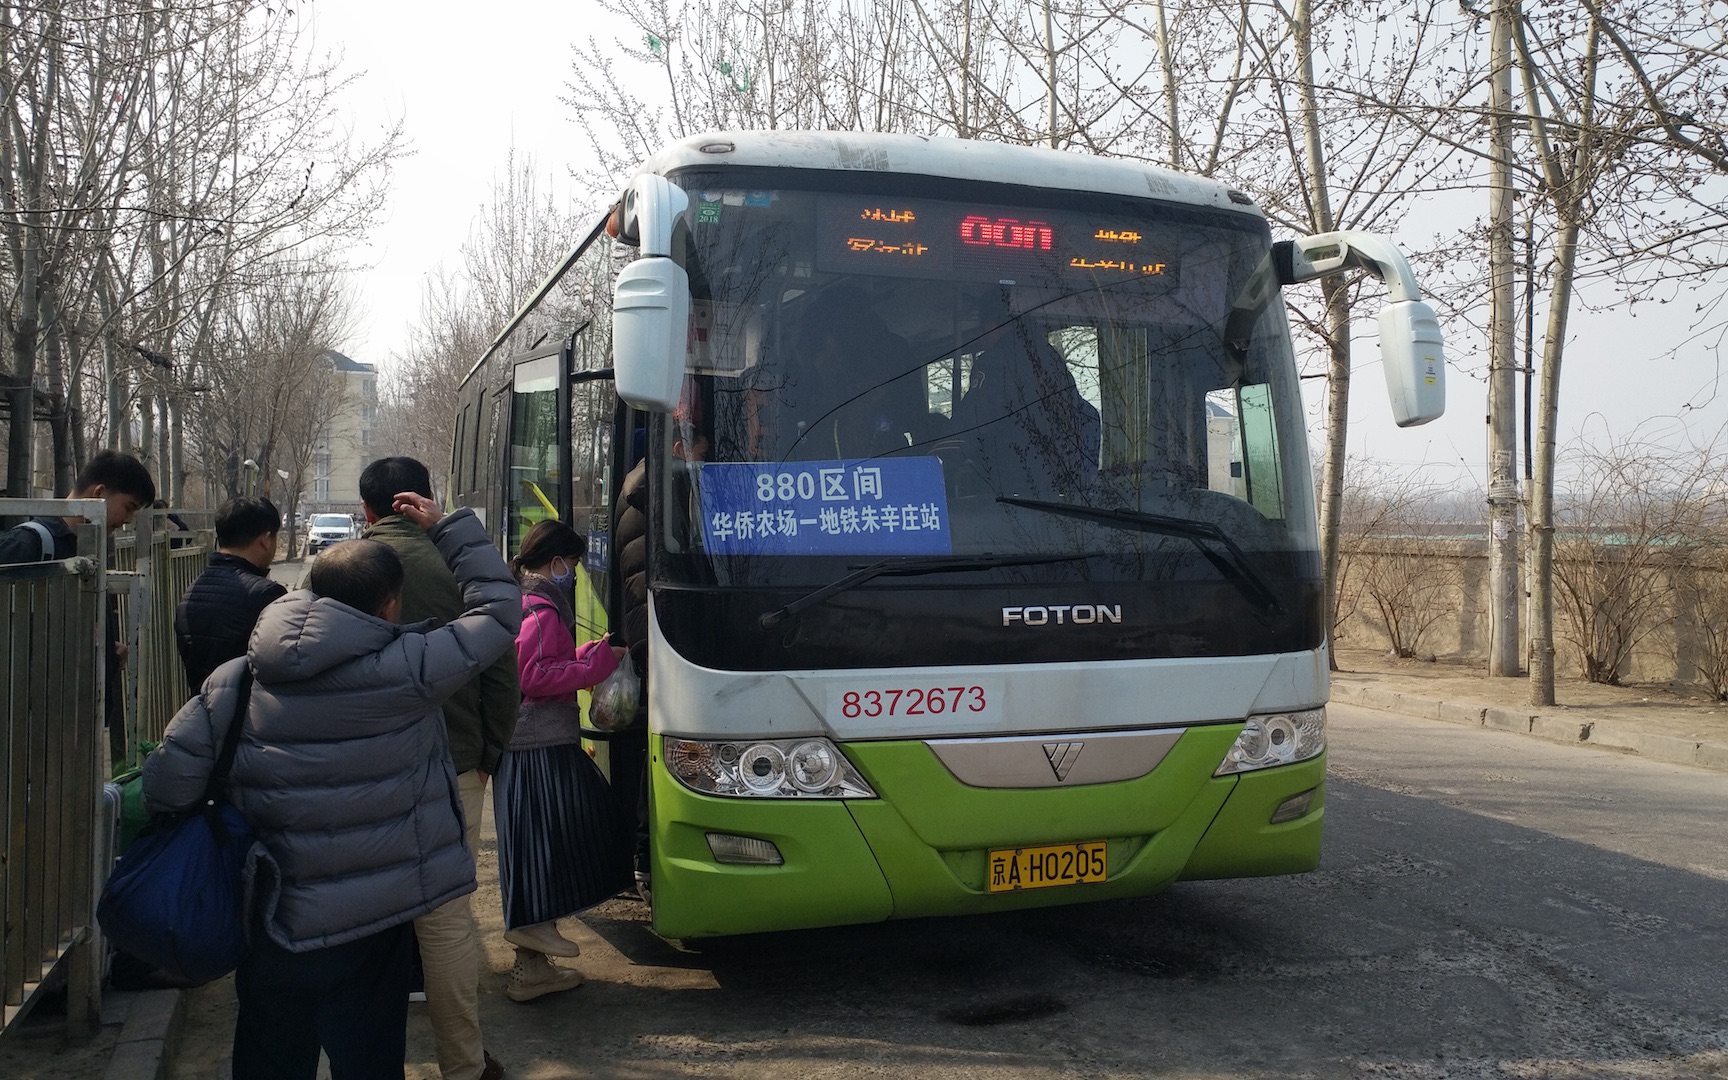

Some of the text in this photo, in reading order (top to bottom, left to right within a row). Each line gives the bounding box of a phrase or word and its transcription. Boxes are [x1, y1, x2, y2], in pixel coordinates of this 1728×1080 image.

[699, 215, 719, 223] 2018
[757, 465, 883, 502] 880区间
[1002, 604, 1122, 626] FOTON
[842, 686, 986, 718] 8372673
